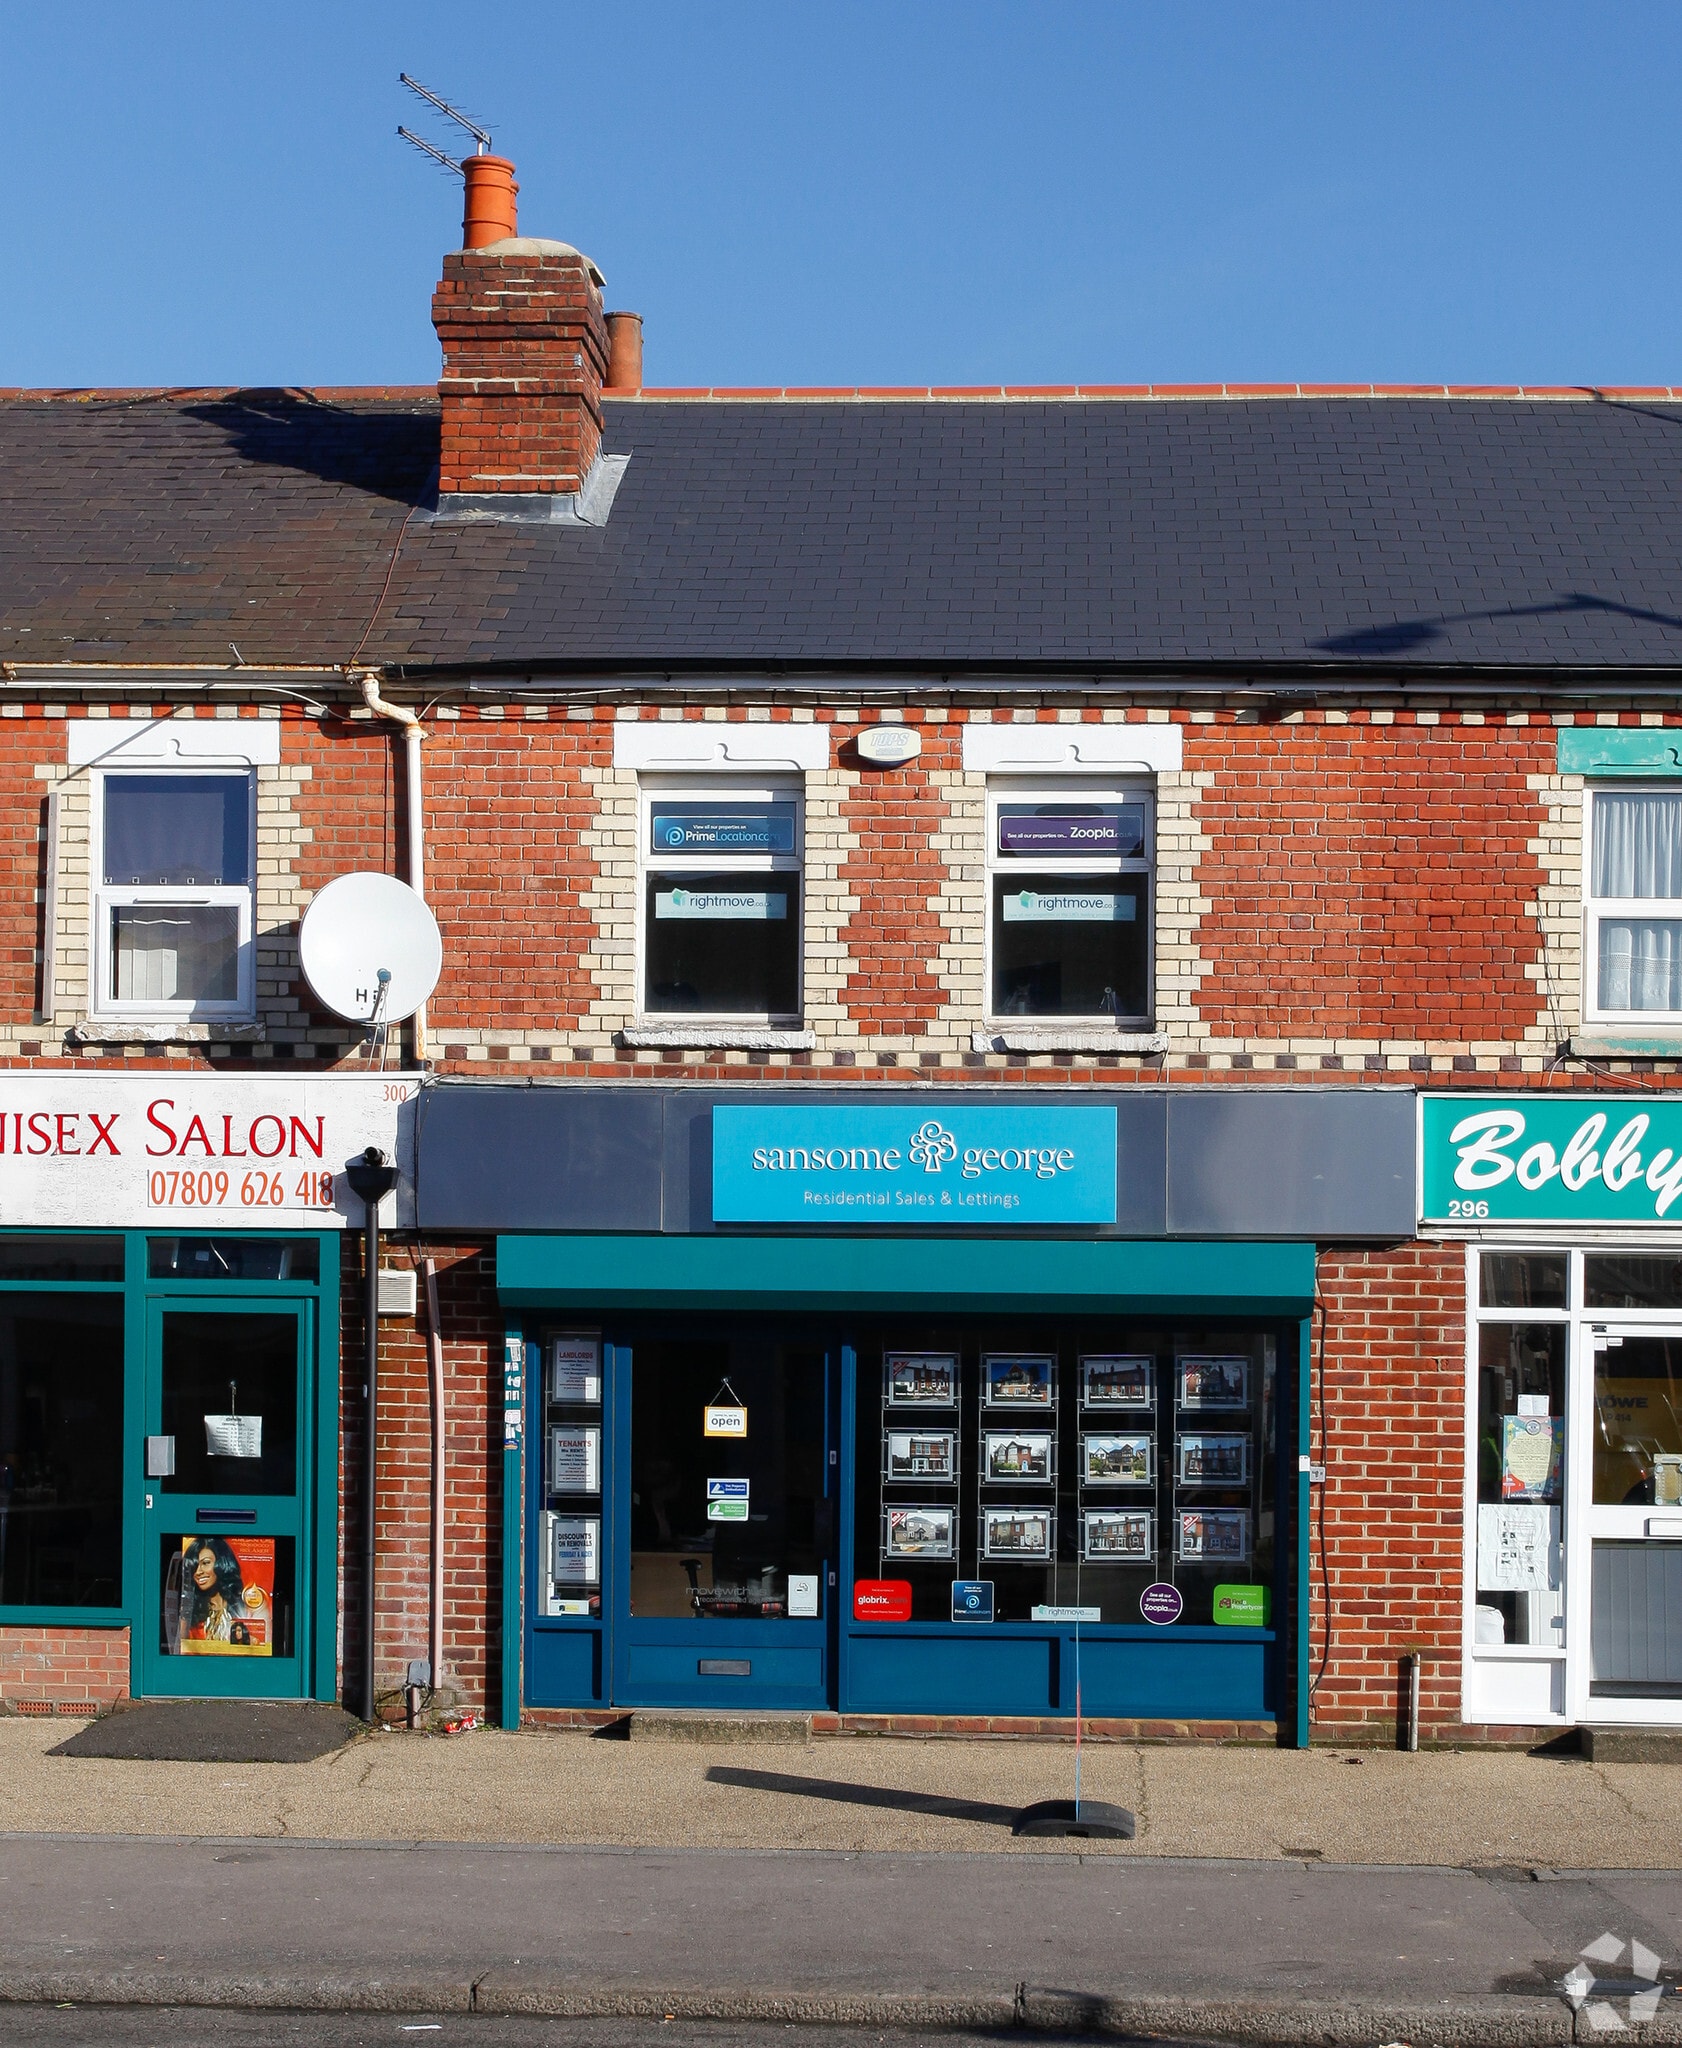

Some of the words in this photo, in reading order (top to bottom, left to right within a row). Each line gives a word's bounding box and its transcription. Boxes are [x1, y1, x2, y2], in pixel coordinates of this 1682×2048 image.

[383, 1084, 407, 1103] 300
[752, 1148, 901, 1171] sansome
[961, 1148, 1075, 1180] george
[150, 1170, 229, 1206] 07809
[241, 1171, 284, 1206] 626
[296, 1171, 334, 1207] 418
[804, 1190, 890, 1206] Residential
[895, 1190, 935, 1206] Sales
[940, 1190, 952, 1206] &
[958, 1190, 1020, 1209] Lettings
[1448, 1200, 1489, 1218] 296
[559, 1351, 593, 1359] LANDLORDS
[711, 1417, 741, 1428] open
[558, 1440, 592, 1448] TENANTS
[558, 1532, 592, 1540] DISCOUNTS
